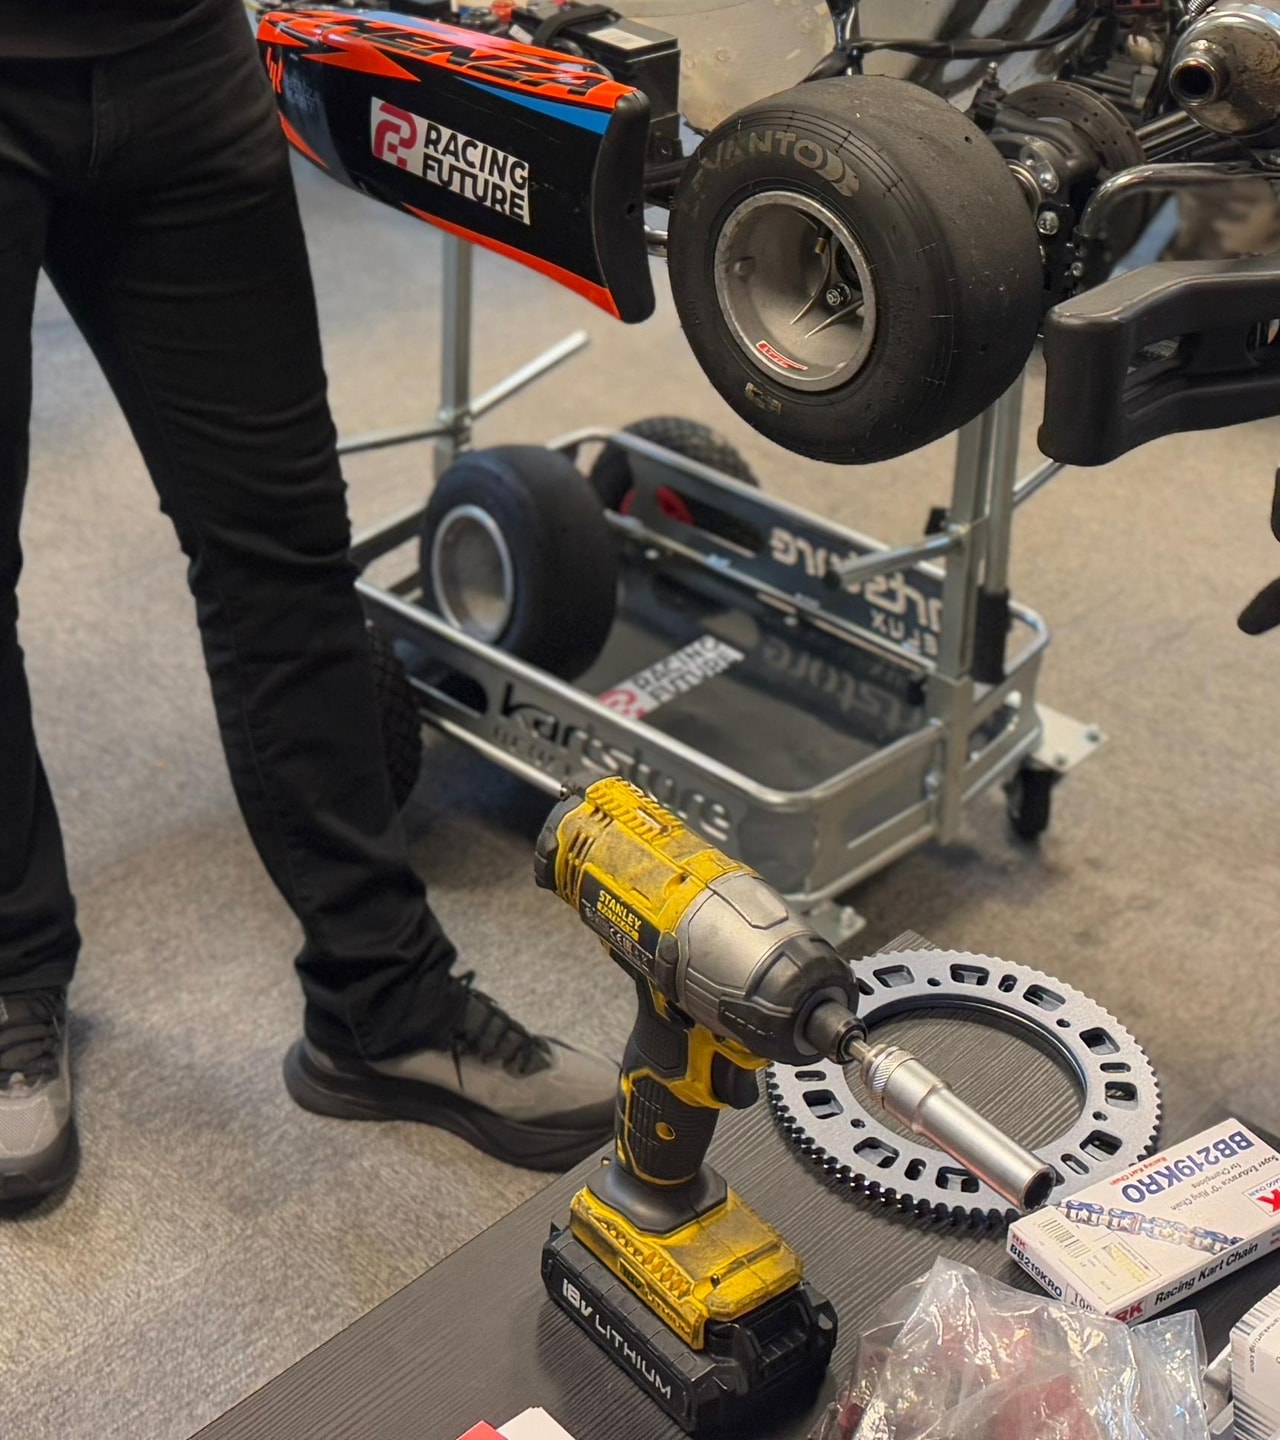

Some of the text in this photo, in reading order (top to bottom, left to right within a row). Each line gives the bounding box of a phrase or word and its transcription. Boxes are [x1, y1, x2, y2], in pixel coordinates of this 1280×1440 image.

[424, 122, 528, 191] RACING
[422, 152, 525, 222] FUTURE
[598, 889, 642, 930] STANLEY
[1121, 1130, 1255, 1203] BB219KRO
[1191, 1167, 1230, 1188] Champions
[1224, 1163, 1261, 1186] Endurance
[1261, 1155, 1280, 1168] Super
[1170, 1197, 1192, 1211] Chain
[1010, 1243, 1063, 1297] BB219KRO
[1154, 1276, 1196, 1306] Racing
[1198, 1261, 1225, 1283] Kart
[1226, 1242, 1258, 1266] Chain
[596, 1314, 671, 1399] LITHIUM
